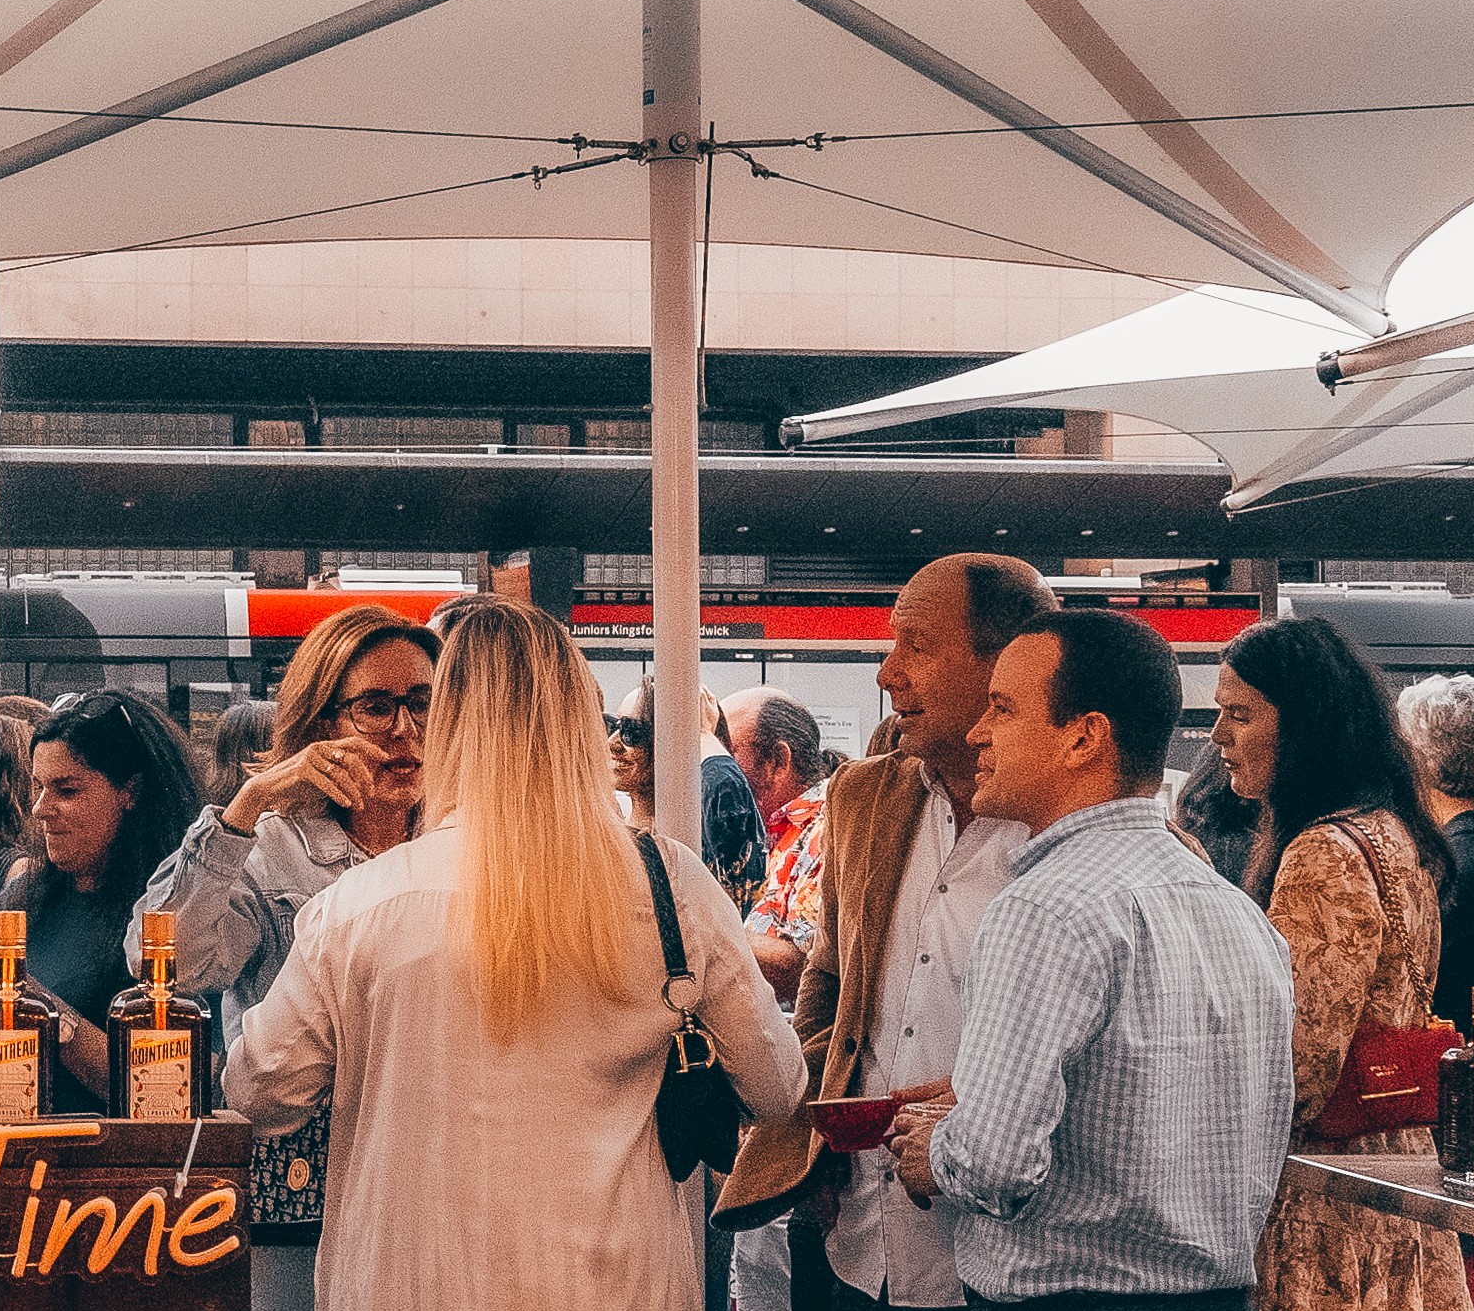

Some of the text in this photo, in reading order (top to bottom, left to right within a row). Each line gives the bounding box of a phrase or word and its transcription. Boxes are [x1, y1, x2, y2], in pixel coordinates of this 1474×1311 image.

[571, 624, 610, 636] Juniors
[612, 624, 655, 638] Kingsfo
[700, 624, 730, 636] dwick
[131, 1038, 189, 1066] COINTREAU
